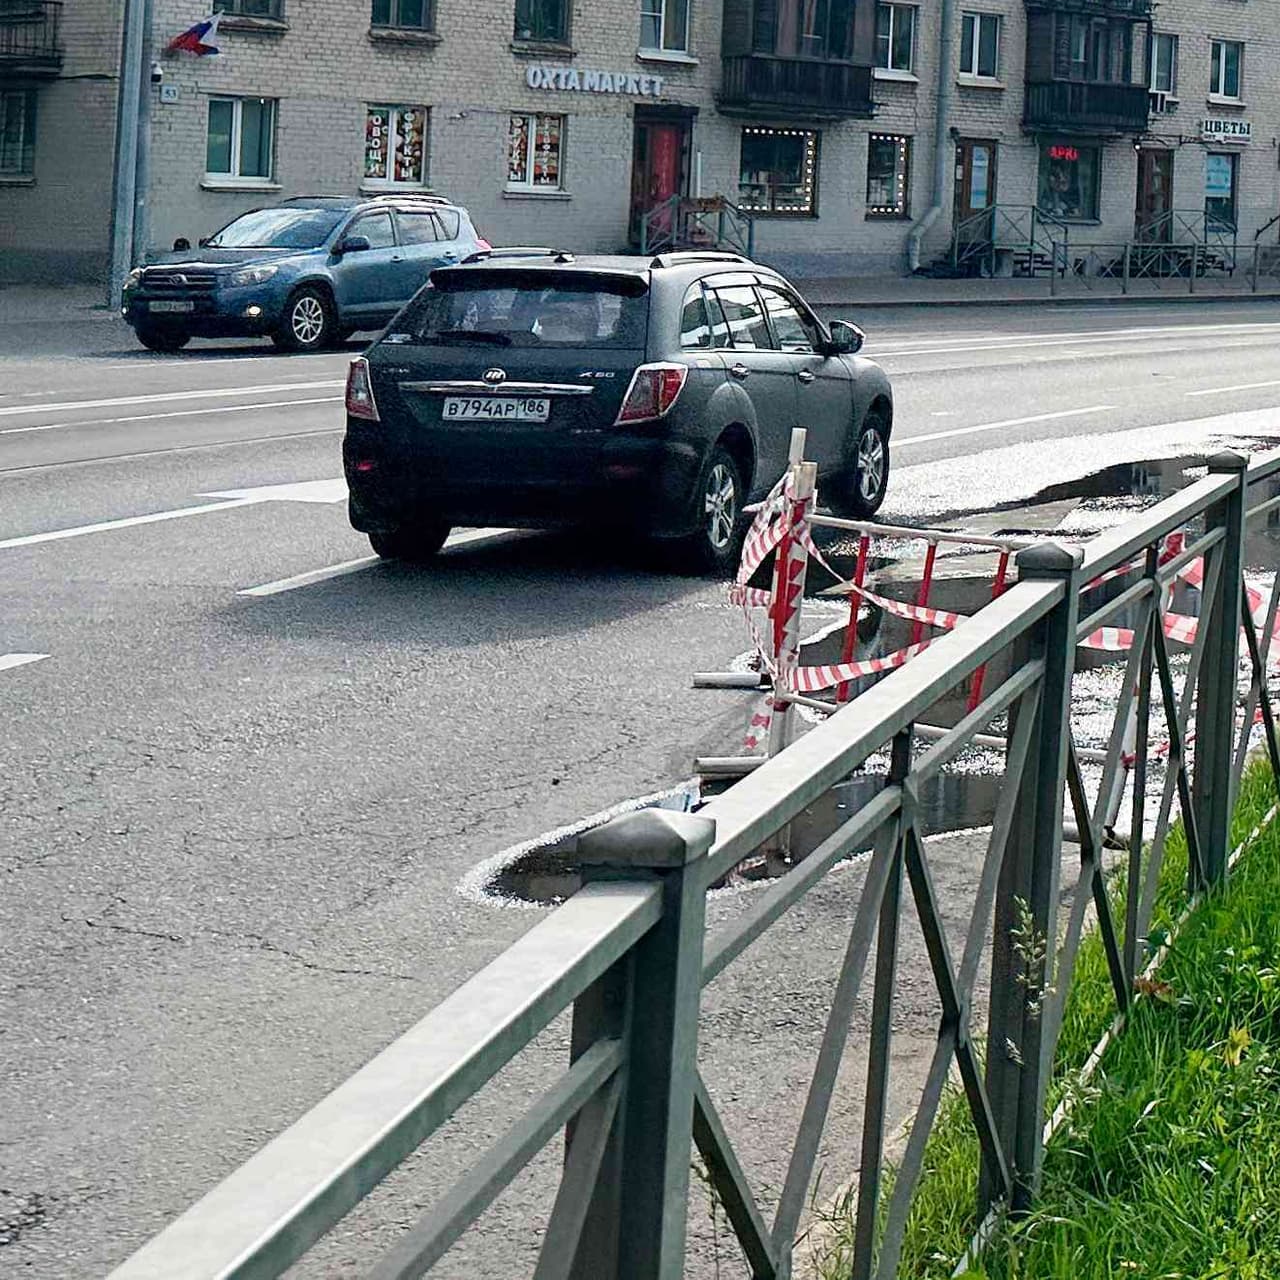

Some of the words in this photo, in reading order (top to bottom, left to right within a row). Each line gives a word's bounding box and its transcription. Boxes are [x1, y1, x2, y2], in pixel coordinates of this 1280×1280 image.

[368, 115, 382, 175] ОВОЩИ
[401, 112, 415, 178] ФРУКТЫ
[1204, 120, 1251, 135] ЦВЕТЫ
[519, 400, 544, 413] 186
